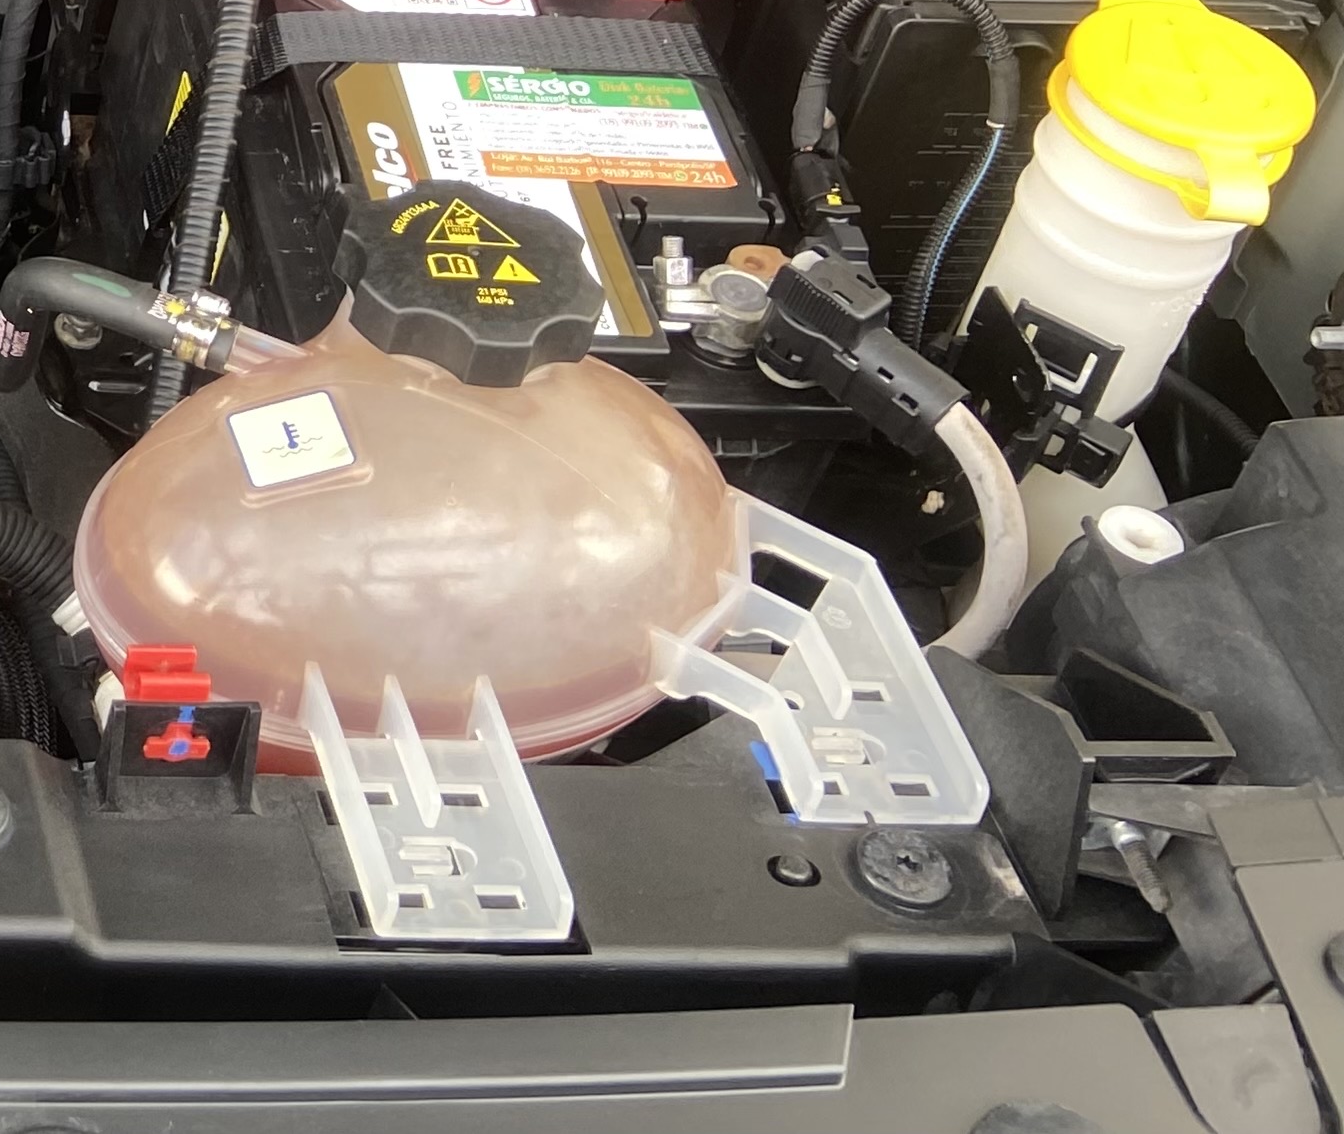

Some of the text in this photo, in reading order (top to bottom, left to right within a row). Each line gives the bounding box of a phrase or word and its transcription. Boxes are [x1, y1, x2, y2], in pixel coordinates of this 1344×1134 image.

[486, 74, 591, 97] SÉRGIO
[428, 125, 459, 170] FREE
[690, 170, 726, 184] 24h
[477, 287, 489, 296] 21
